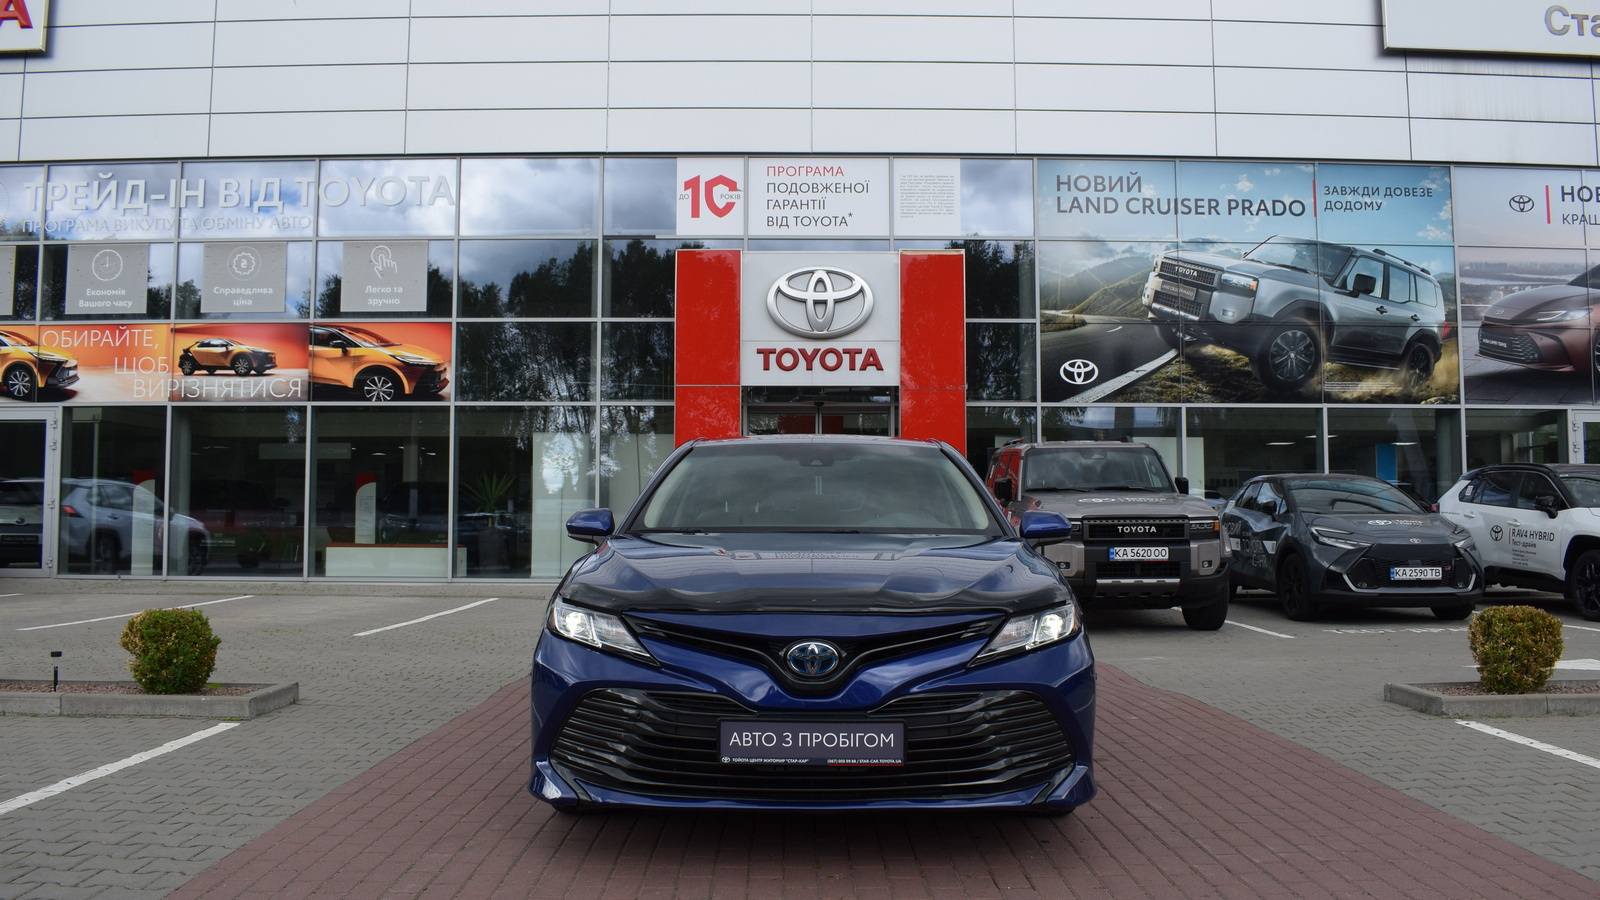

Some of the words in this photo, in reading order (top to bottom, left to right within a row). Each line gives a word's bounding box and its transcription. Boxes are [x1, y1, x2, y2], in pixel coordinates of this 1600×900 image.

[766, 166, 844, 176] ПРОГРАМА
[766, 180, 870, 195] ПОДОВЖЕНОЇ
[1056, 172, 1142, 193] НОВИЙ
[24, 172, 206, 216] ТРЕЙД-ІН
[219, 178, 285, 214] ВІД
[294, 175, 456, 208] TOYOTA
[1324, 186, 1380, 198] ЗАВЖДИ
[1384, 187, 1433, 199] ДОВЕЗЕ
[766, 197, 826, 210] ГАРАНТІЇ
[1056, 196, 1118, 214] LAND
[1126, 197, 1220, 216] CRUISER
[1227, 198, 1306, 217] PRADO
[1324, 200, 1383, 212] ДОДОМУ
[22, 218, 108, 233] ПРОГРАМА
[114, 217, 174, 232] ВИКУПУ
[201, 216, 266, 231] ОБМІНУ
[269, 216, 312, 229] АВТО
[766, 216, 790, 228] ВІД
[1175, 266, 1198, 276] TOYOTA
[86, 288, 126, 296] Економія
[213, 286, 274, 296] Справедлива
[365, 285, 392, 294] Легко
[79, 300, 112, 308] Вашого
[113, 300, 132, 308] часу
[233, 297, 253, 306] ціна
[368, 298, 400, 306] зручно
[41, 325, 159, 350] ОБИРАЙТЕ,
[114, 356, 168, 376] ЩОБ
[756, 348, 884, 372] TOYOTA
[133, 378, 302, 398] ВИРІЗНЯТИСЯ
[1512, 528, 1528, 538] RAV4
[1529, 530, 1555, 542] HYBRID
[1512, 539, 1537, 548] Тест-драйв
[1115, 548, 1129, 558] KA
[1130, 548, 1152, 558] 5620
[1396, 569, 1408, 577] KA
[1409, 569, 1428, 577] 2590
[1430, 568, 1440, 577] TB
[729, 732, 777, 748] АВТО
[782, 732, 793, 748] З
[798, 732, 894, 748] ПРОБІГОМ
